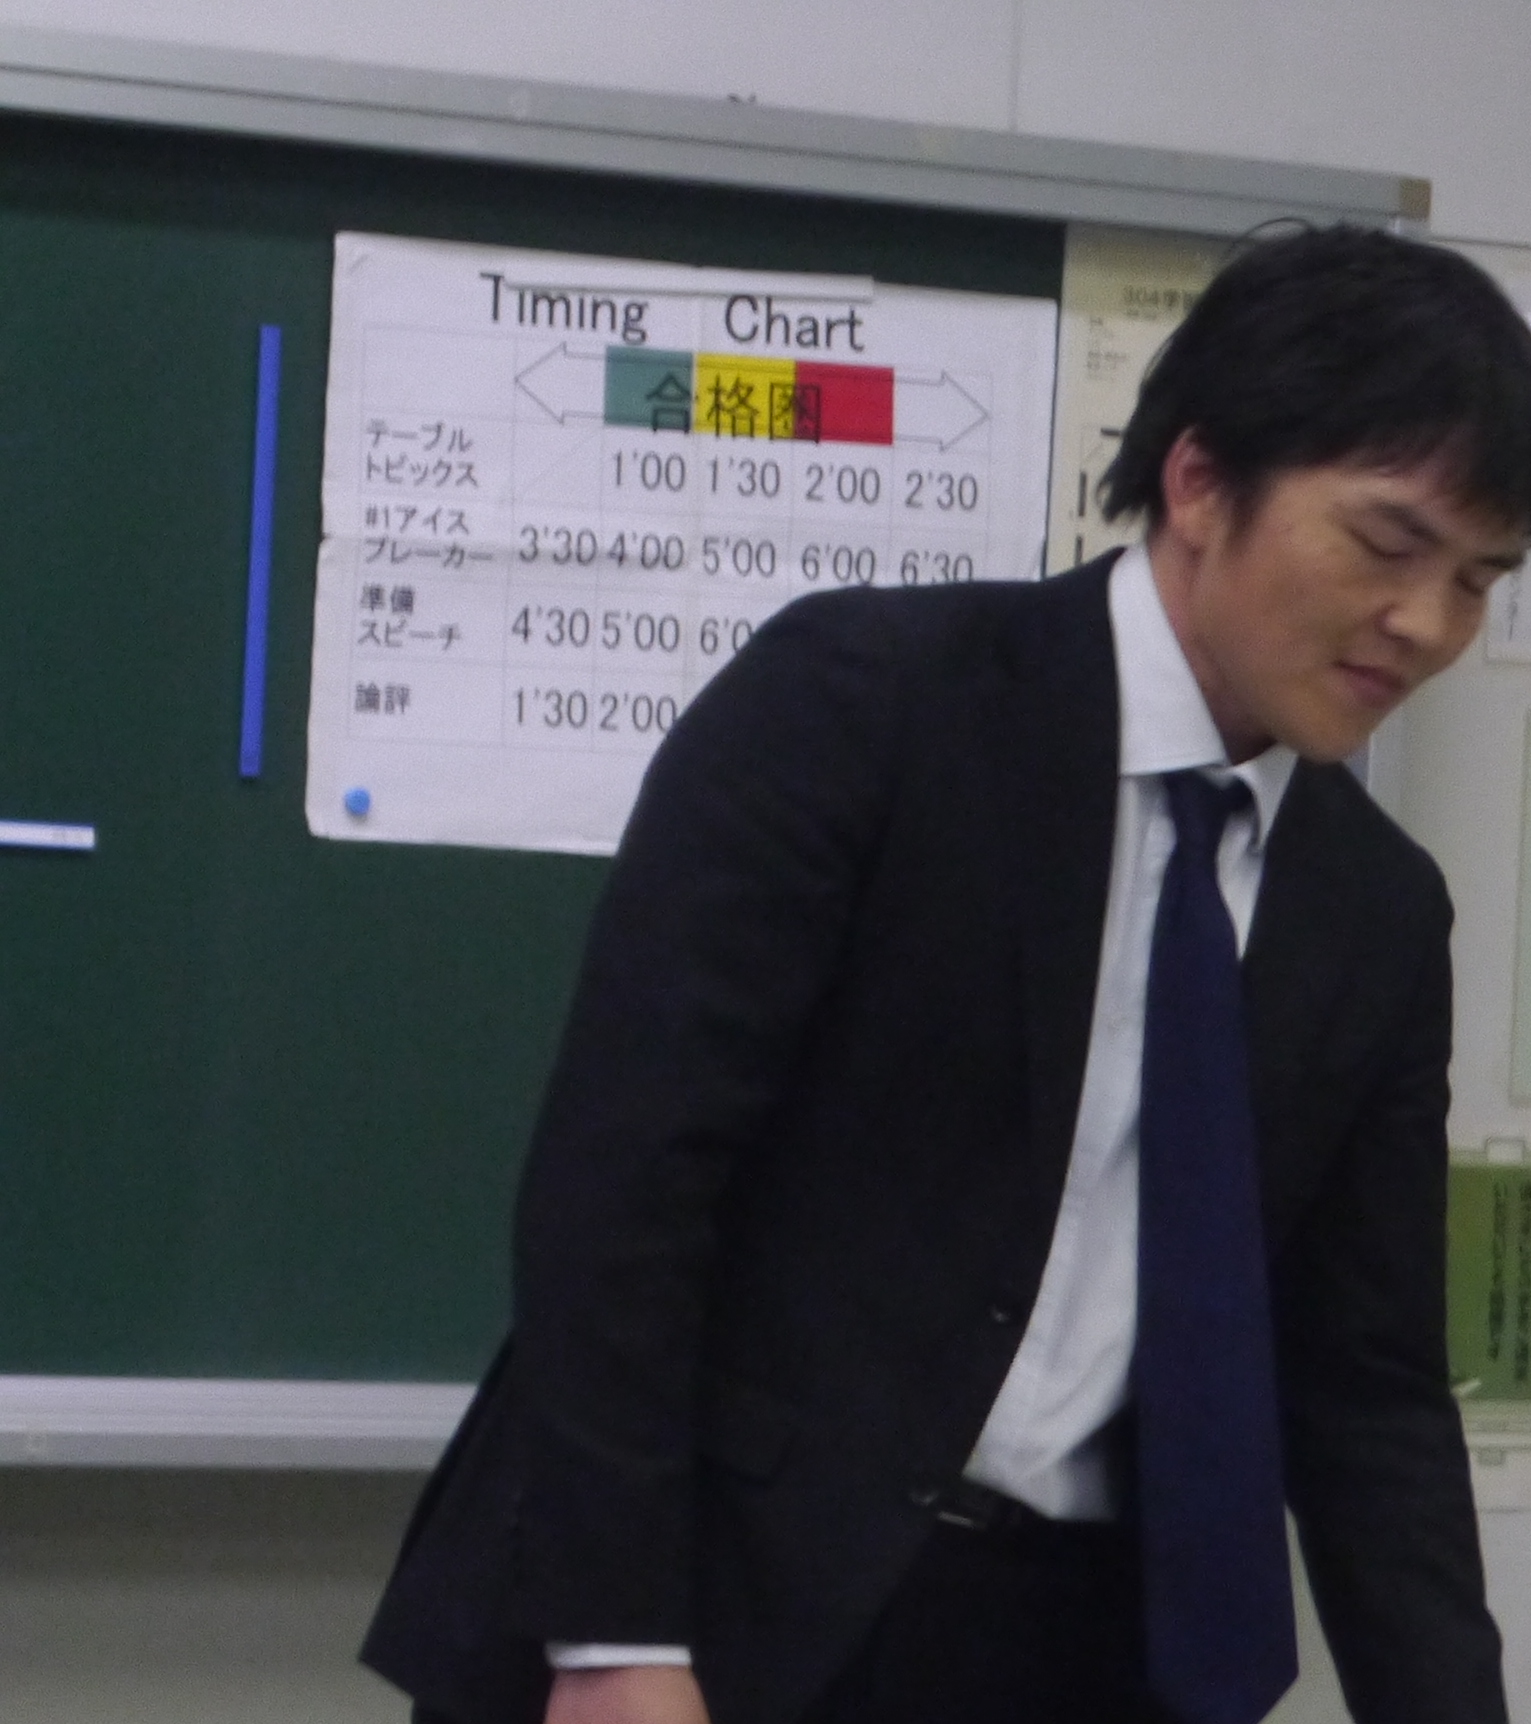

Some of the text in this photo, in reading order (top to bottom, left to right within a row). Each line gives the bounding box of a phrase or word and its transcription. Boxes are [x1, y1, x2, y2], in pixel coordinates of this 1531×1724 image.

[479, 271, 865, 353] Timing Chart
[645, 371, 822, 446] 合格圏
[365, 418, 473, 452] テーブル
[366, 451, 479, 487] トピックス
[613, 450, 979, 511] 1'00 1'30 2'00 2'30
[365, 505, 470, 535] #1アイス
[365, 535, 494, 569] ブレーカー
[518, 524, 599, 567] 3'30
[607, 531, 685, 571] 4'00
[702, 535, 777, 578] 5'00
[801, 543, 877, 586] 6'00
[360, 582, 416, 616] 準備
[357, 616, 461, 651] スピーチ
[511, 604, 754, 656] 4'30 5'00 6'0
[355, 680, 411, 715] 論評
[515, 686, 677, 733] 1'30 2'00
